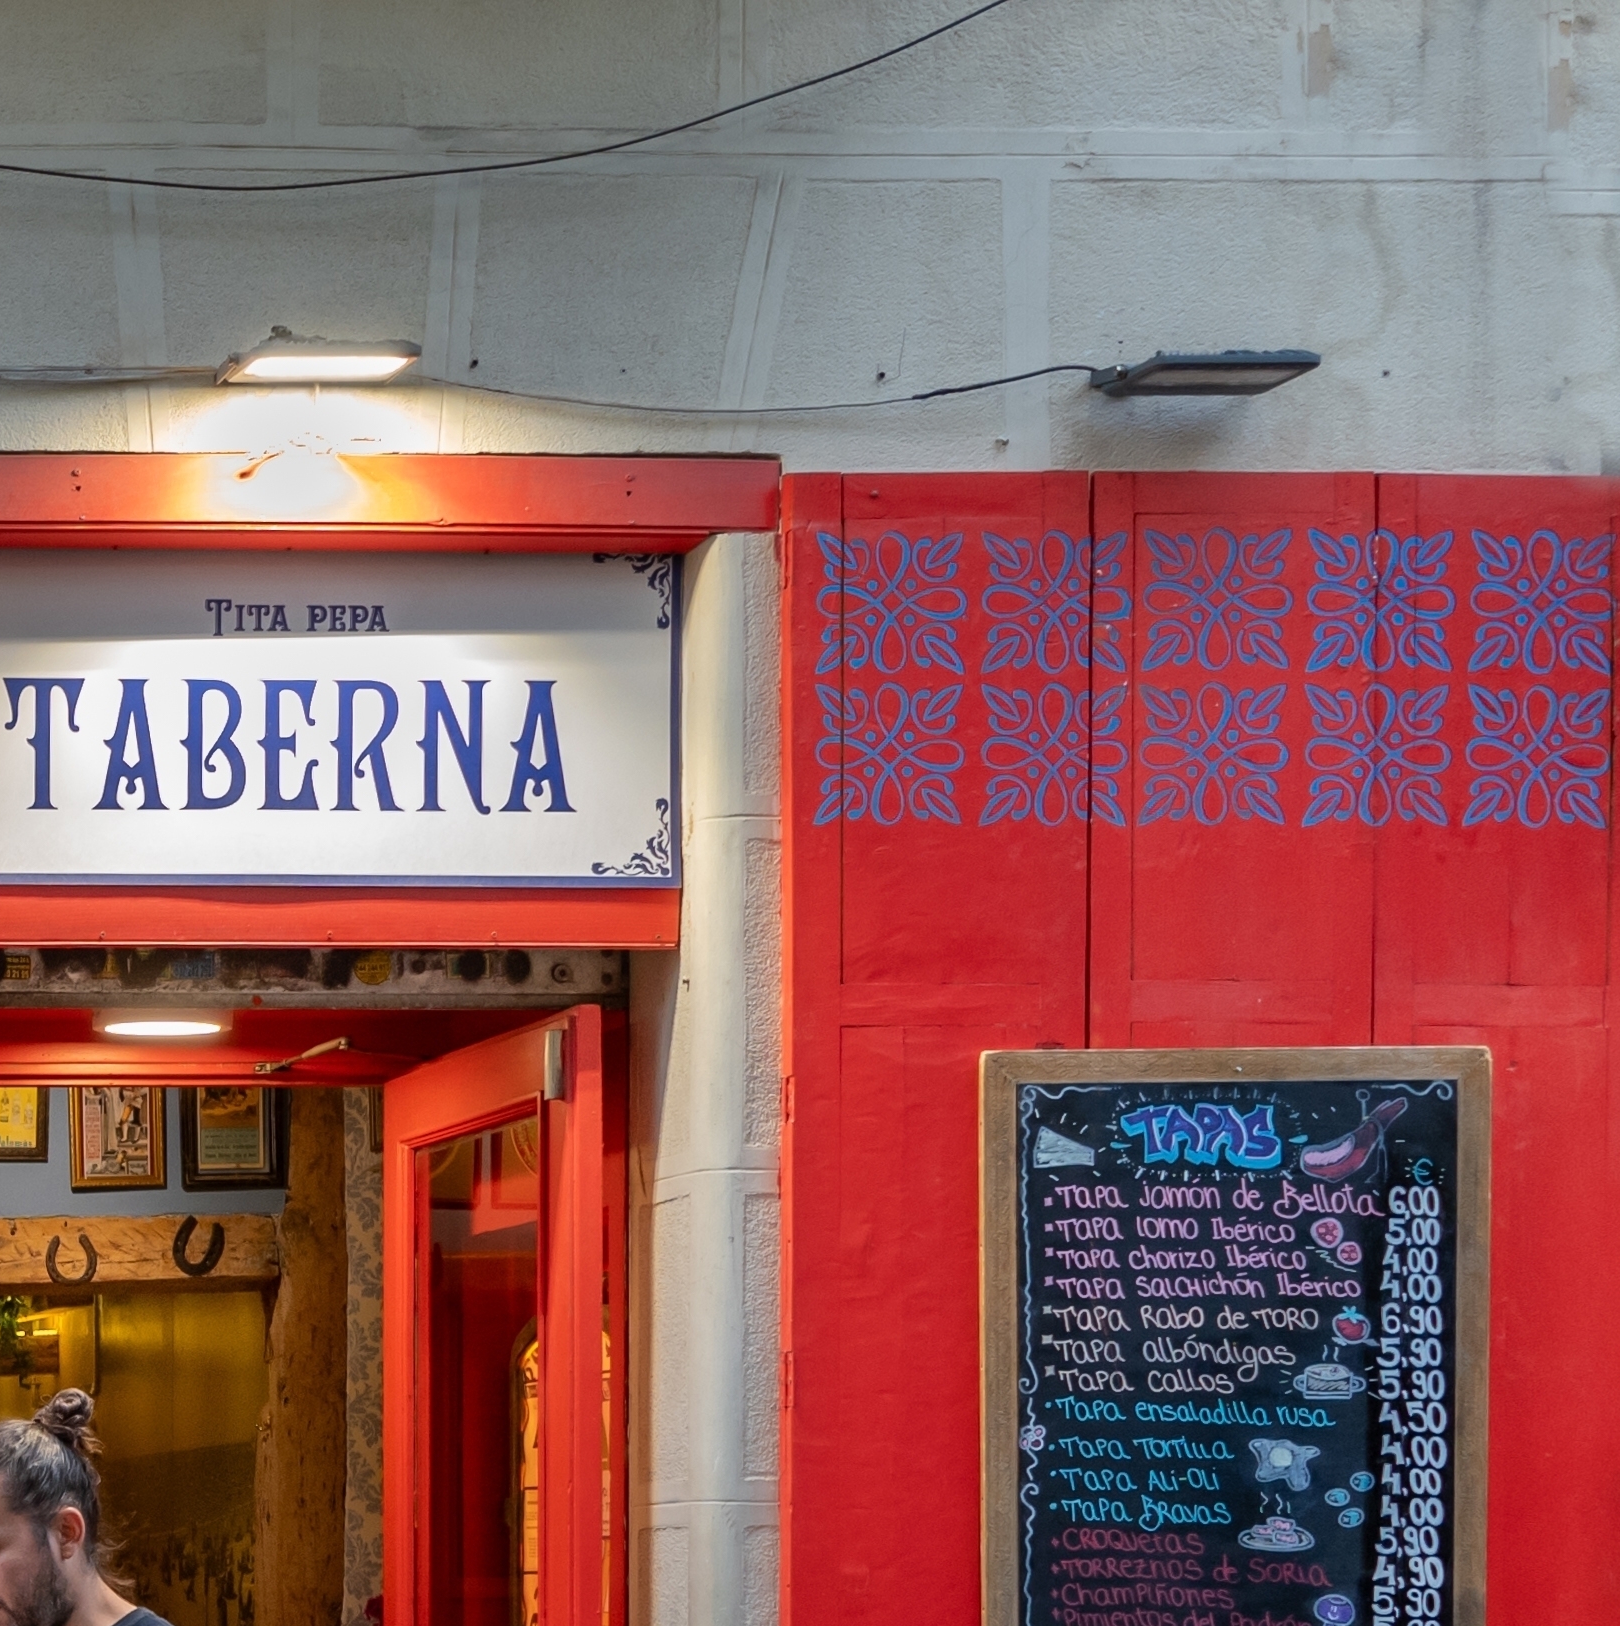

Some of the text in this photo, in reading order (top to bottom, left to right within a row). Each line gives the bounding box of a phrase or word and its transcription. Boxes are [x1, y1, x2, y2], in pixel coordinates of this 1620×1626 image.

[205, 598, 390, 636] TITA PEPA
[2, 677, 578, 816] TABERNA
[1120, 1103, 1282, 1169] TAPAS
[1140, 1178, 1221, 1210] jamón
[1232, 1178, 1264, 1211] de
[1273, 1181, 1386, 1219] Bellota
[1388, 1185, 1440, 1220] 6,00
[1137, 1216, 1199, 1241] lomo
[1212, 1216, 1296, 1243] Ibérico
[1385, 1218, 1441, 1246] 5,00
[1128, 1243, 1216, 1270] chorizo
[1226, 1243, 1307, 1271] Ibérico
[1382, 1245, 1438, 1276] 4,00
[1277, 1272, 1361, 1298] Ibérico
[1380, 1270, 1442, 1302] 4,00
[1141, 1305, 1204, 1330] Rabo
[1217, 1304, 1250, 1330] de
[1142, 1334, 1296, 1383] albóndigas
[1135, 1400, 1273, 1427] ensaladilla
[1276, 1405, 1337, 1427] rusa
[1378, 1402, 1447, 1435] 4,50
[1381, 1434, 1448, 1469] 4,00
[1381, 1463, 1442, 1496] 4,00
[1380, 1495, 1445, 1527] 4,00
[1375, 1526, 1440, 1558] 5,90
[1212, 1553, 1445, 1589] de 4,90
[1371, 1585, 1441, 1618] 5,90
